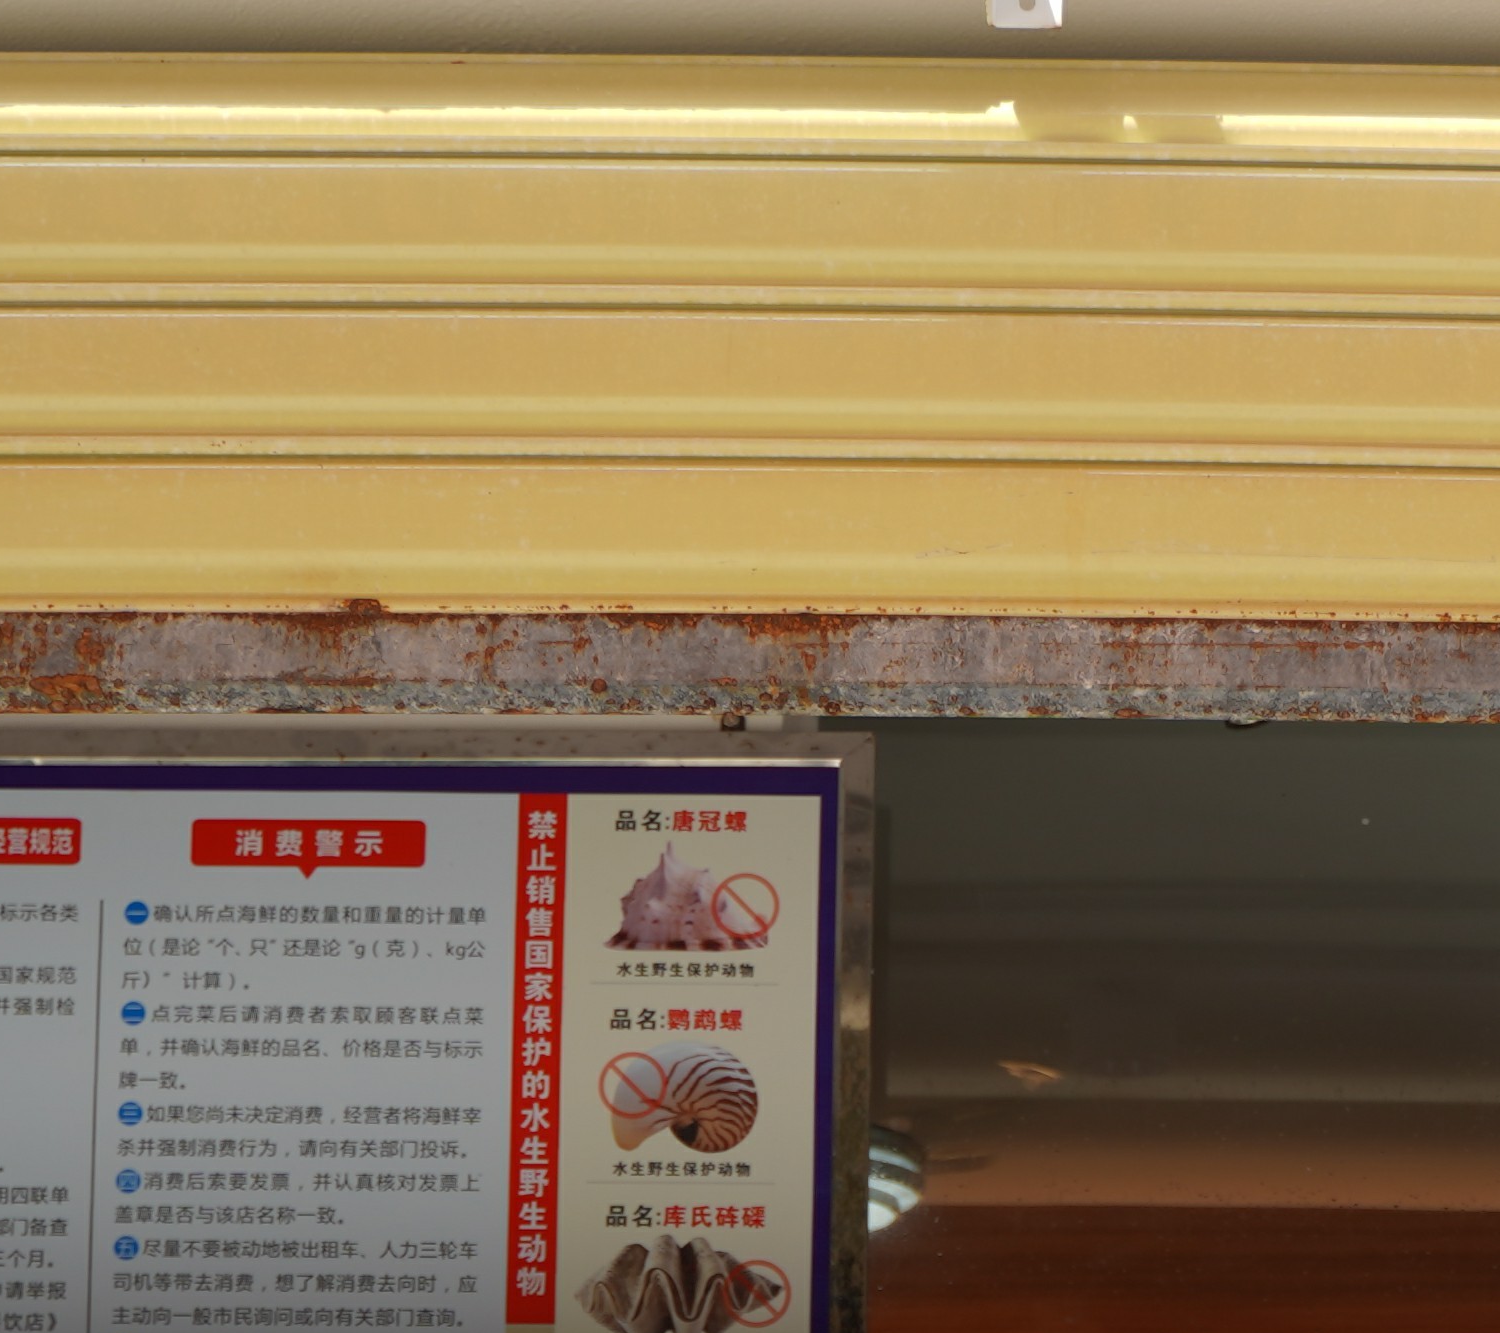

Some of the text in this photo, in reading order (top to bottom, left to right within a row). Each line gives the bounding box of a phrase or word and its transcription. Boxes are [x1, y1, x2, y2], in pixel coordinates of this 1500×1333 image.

[235, 829, 383, 857] 消费警示
[617, 962, 755, 979] 水生野生保护动物
[516, 809, 558, 1297] 禁止销售国家保护的水生野生动物
[612, 1161, 751, 1177] 水生野生保护动物
